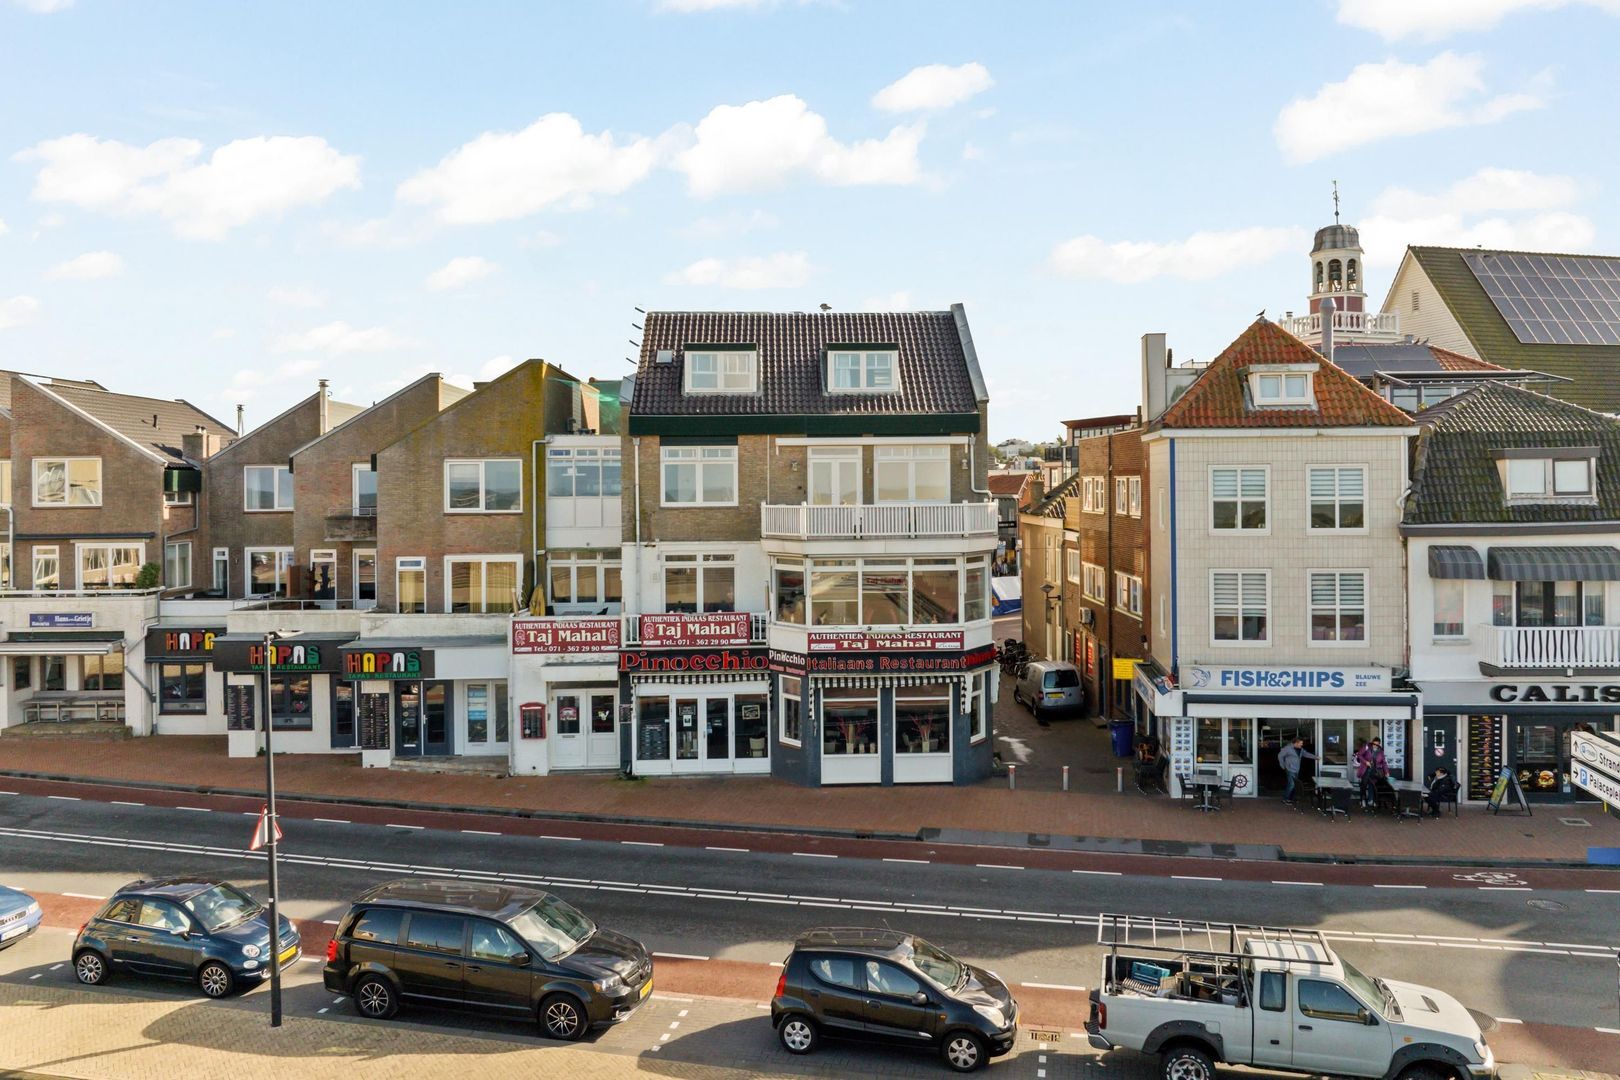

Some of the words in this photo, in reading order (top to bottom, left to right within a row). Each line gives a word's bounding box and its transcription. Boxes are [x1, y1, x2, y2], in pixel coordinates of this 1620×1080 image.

[527, 630, 552, 645] Taj
[558, 629, 607, 642] Mahal
[656, 623, 681, 638] Taj
[687, 623, 736, 636] Mahal
[165, 633, 216, 650] HAPA
[840, 640, 869, 650] Taj
[876, 640, 932, 648] Mahal
[346, 651, 420, 673] HAPAS
[619, 650, 769, 671] Pinocchio
[769, 650, 805, 665] Pinocchio
[807, 657, 874, 670] Italiaans
[880, 656, 967, 670] Restaurant
[1221, 670, 1345, 688] FISH&CHIPS
